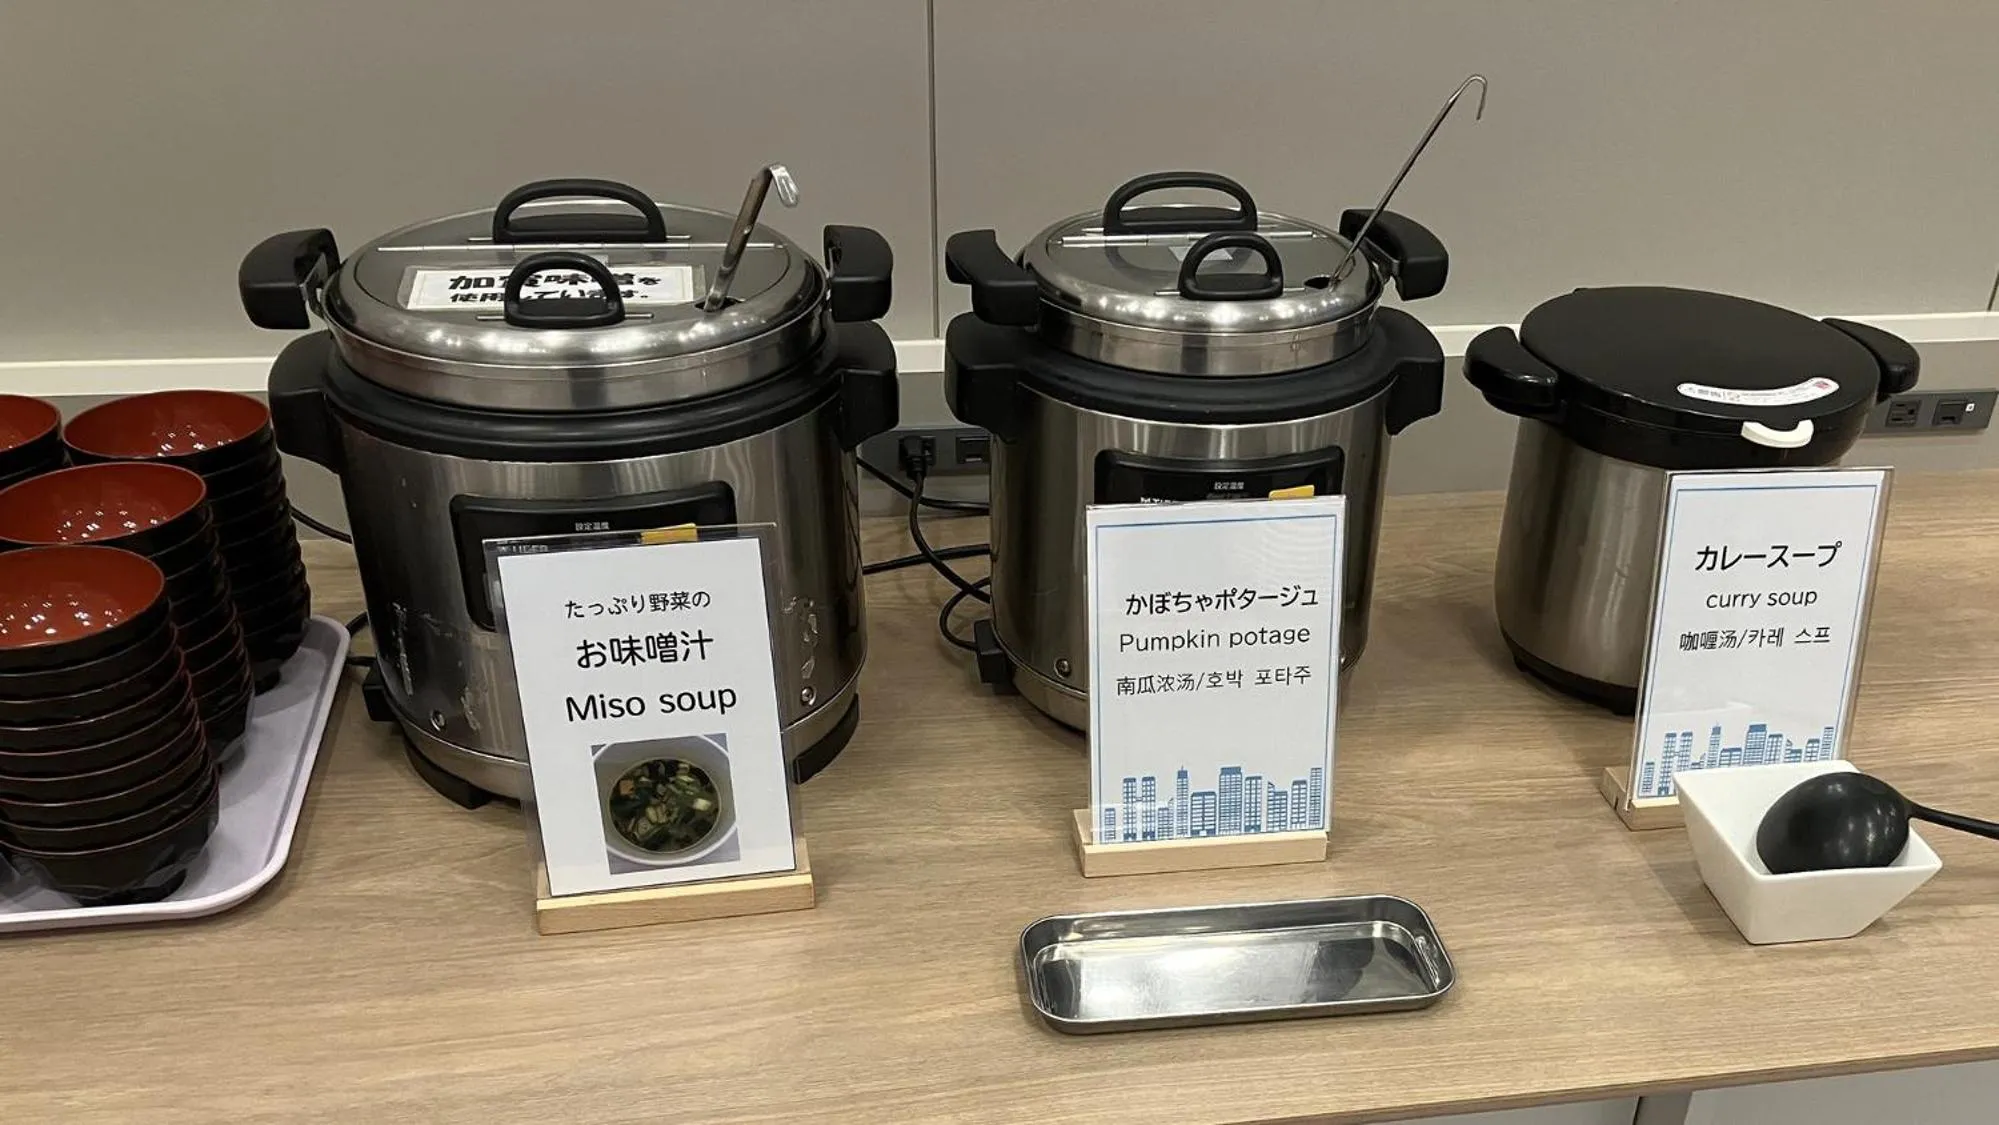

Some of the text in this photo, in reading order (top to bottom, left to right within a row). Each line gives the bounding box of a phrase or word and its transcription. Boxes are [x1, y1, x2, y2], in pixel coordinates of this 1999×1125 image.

[1695, 540, 1843, 571] カレースープ
[564, 590, 711, 619] たっぷり野菜の
[1125, 585, 1319, 616] かぼちゃポタージュ
[1706, 590, 1818, 609] curry soup
[576, 629, 714, 668] お味噌汁
[1120, 627, 1311, 653] Pumpkin potage
[1794, 626, 1831, 644] 스프
[1255, 665, 1312, 686] 포타주
[565, 687, 737, 722] Miso soup
